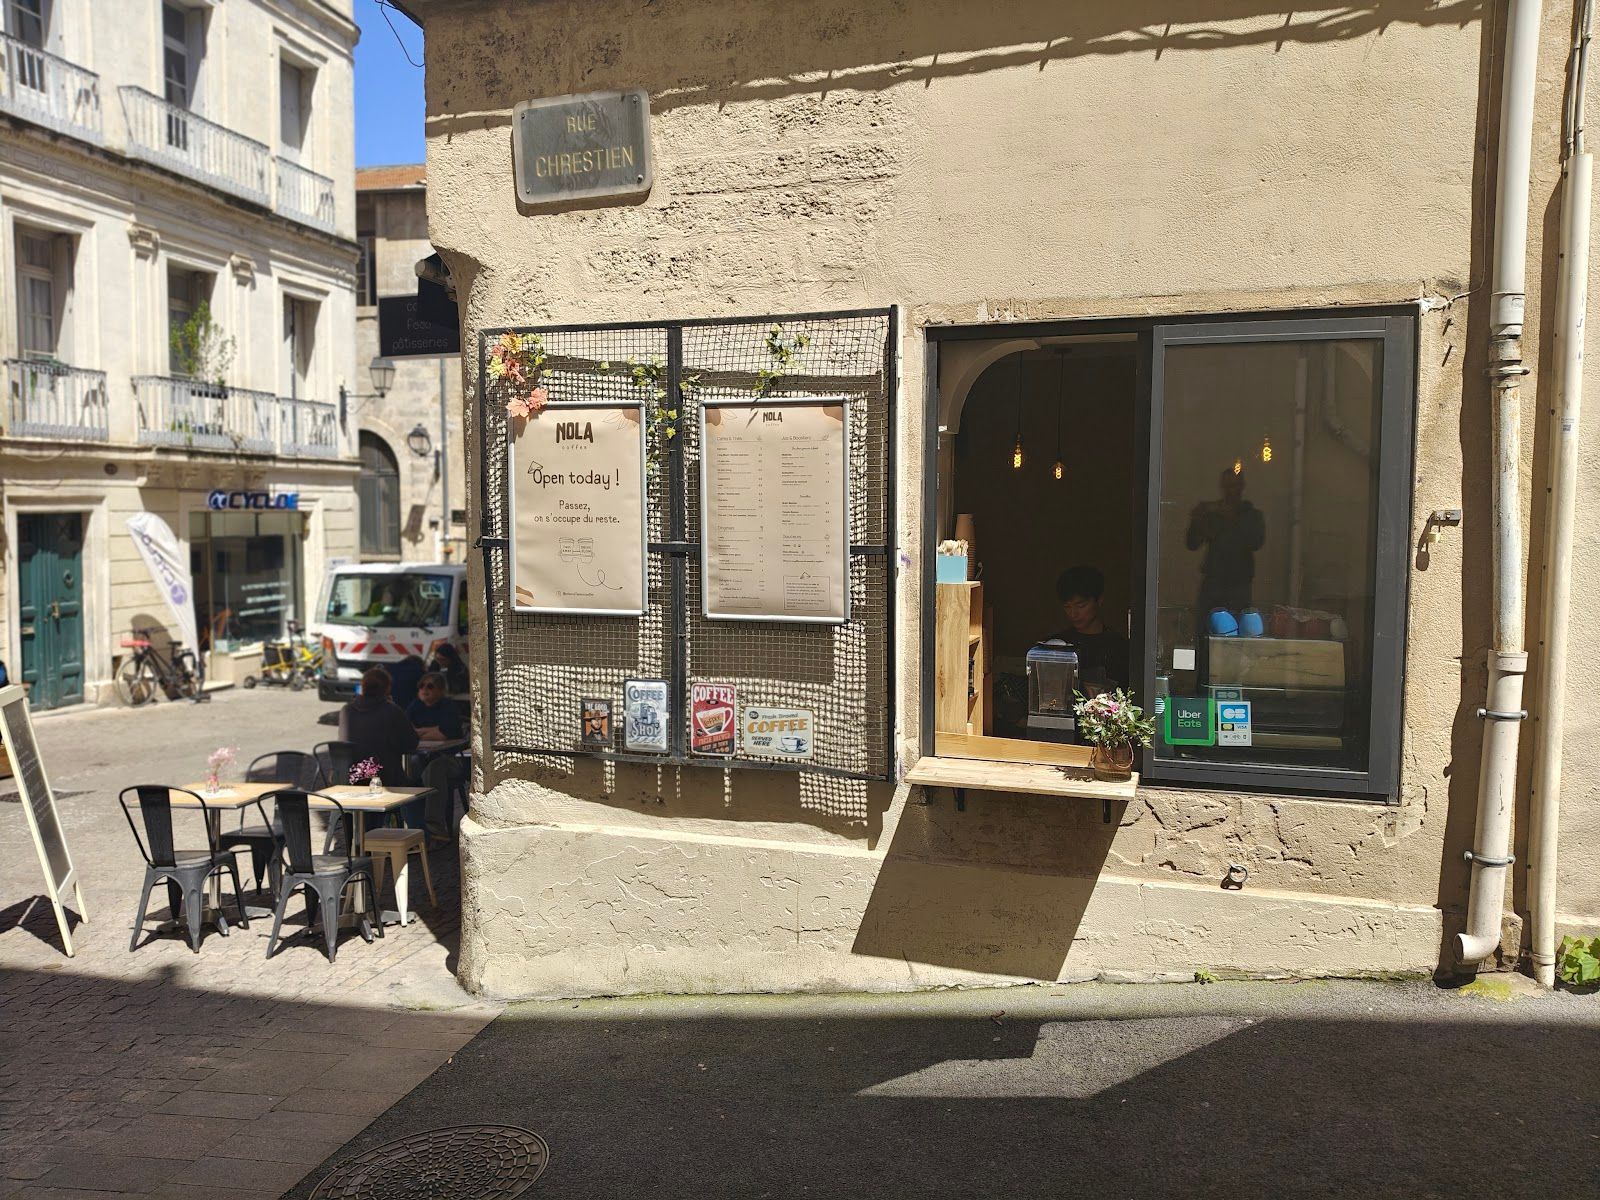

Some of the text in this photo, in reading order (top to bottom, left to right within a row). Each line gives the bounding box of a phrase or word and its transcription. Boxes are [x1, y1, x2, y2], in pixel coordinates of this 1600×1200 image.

[567, 114, 596, 133] RUE
[536, 145, 634, 178] CHRESTIEN
[763, 411, 783, 422] NOLA
[556, 422, 594, 443] NOLA
[533, 468, 565, 489] Open
[569, 469, 611, 490] today
[559, 500, 591, 512] Passez,
[546, 512, 580, 525] s'occupe
[583, 514, 594, 523] du
[628, 686, 664, 702] COFFEE
[694, 686, 734, 704] COFFEE
[1177, 709, 1201, 719] Uber
[747, 718, 808, 734] COFFEE
[1178, 719, 1202, 728] Eats
